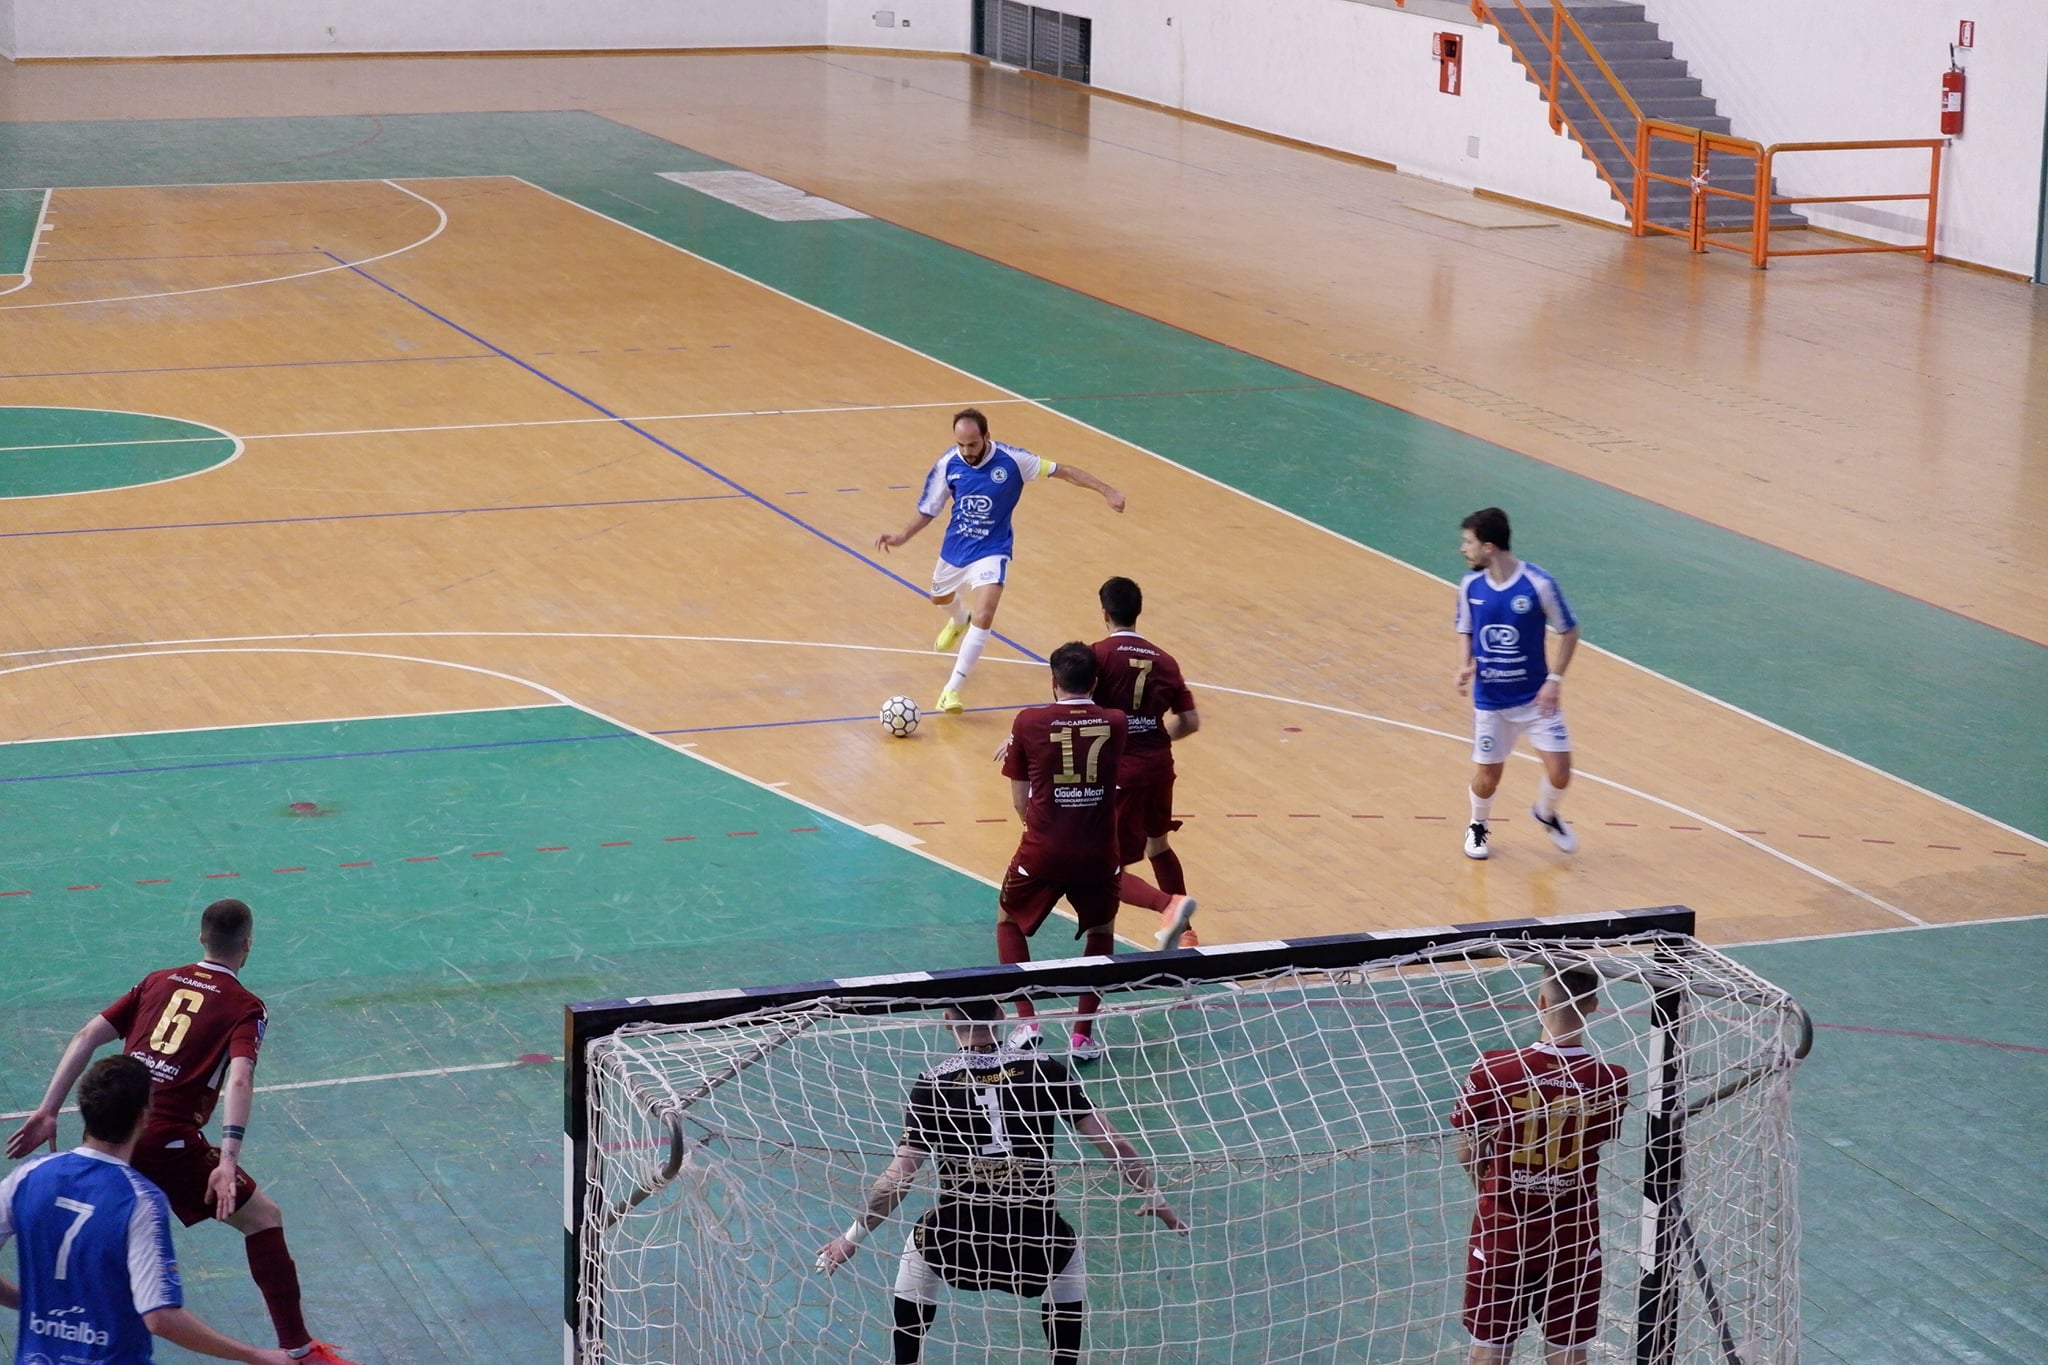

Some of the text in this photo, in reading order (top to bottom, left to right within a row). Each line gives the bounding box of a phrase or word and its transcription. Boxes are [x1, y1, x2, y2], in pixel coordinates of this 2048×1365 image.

[1128, 658, 1153, 710] 7
[1050, 726, 1111, 784] 17
[1054, 787, 1082, 798] Claudio
[150, 988, 204, 1055] 6
[974, 1087, 1013, 1155] 1
[1511, 1089, 1591, 1169] 10
[54, 1196, 96, 1280] 7
